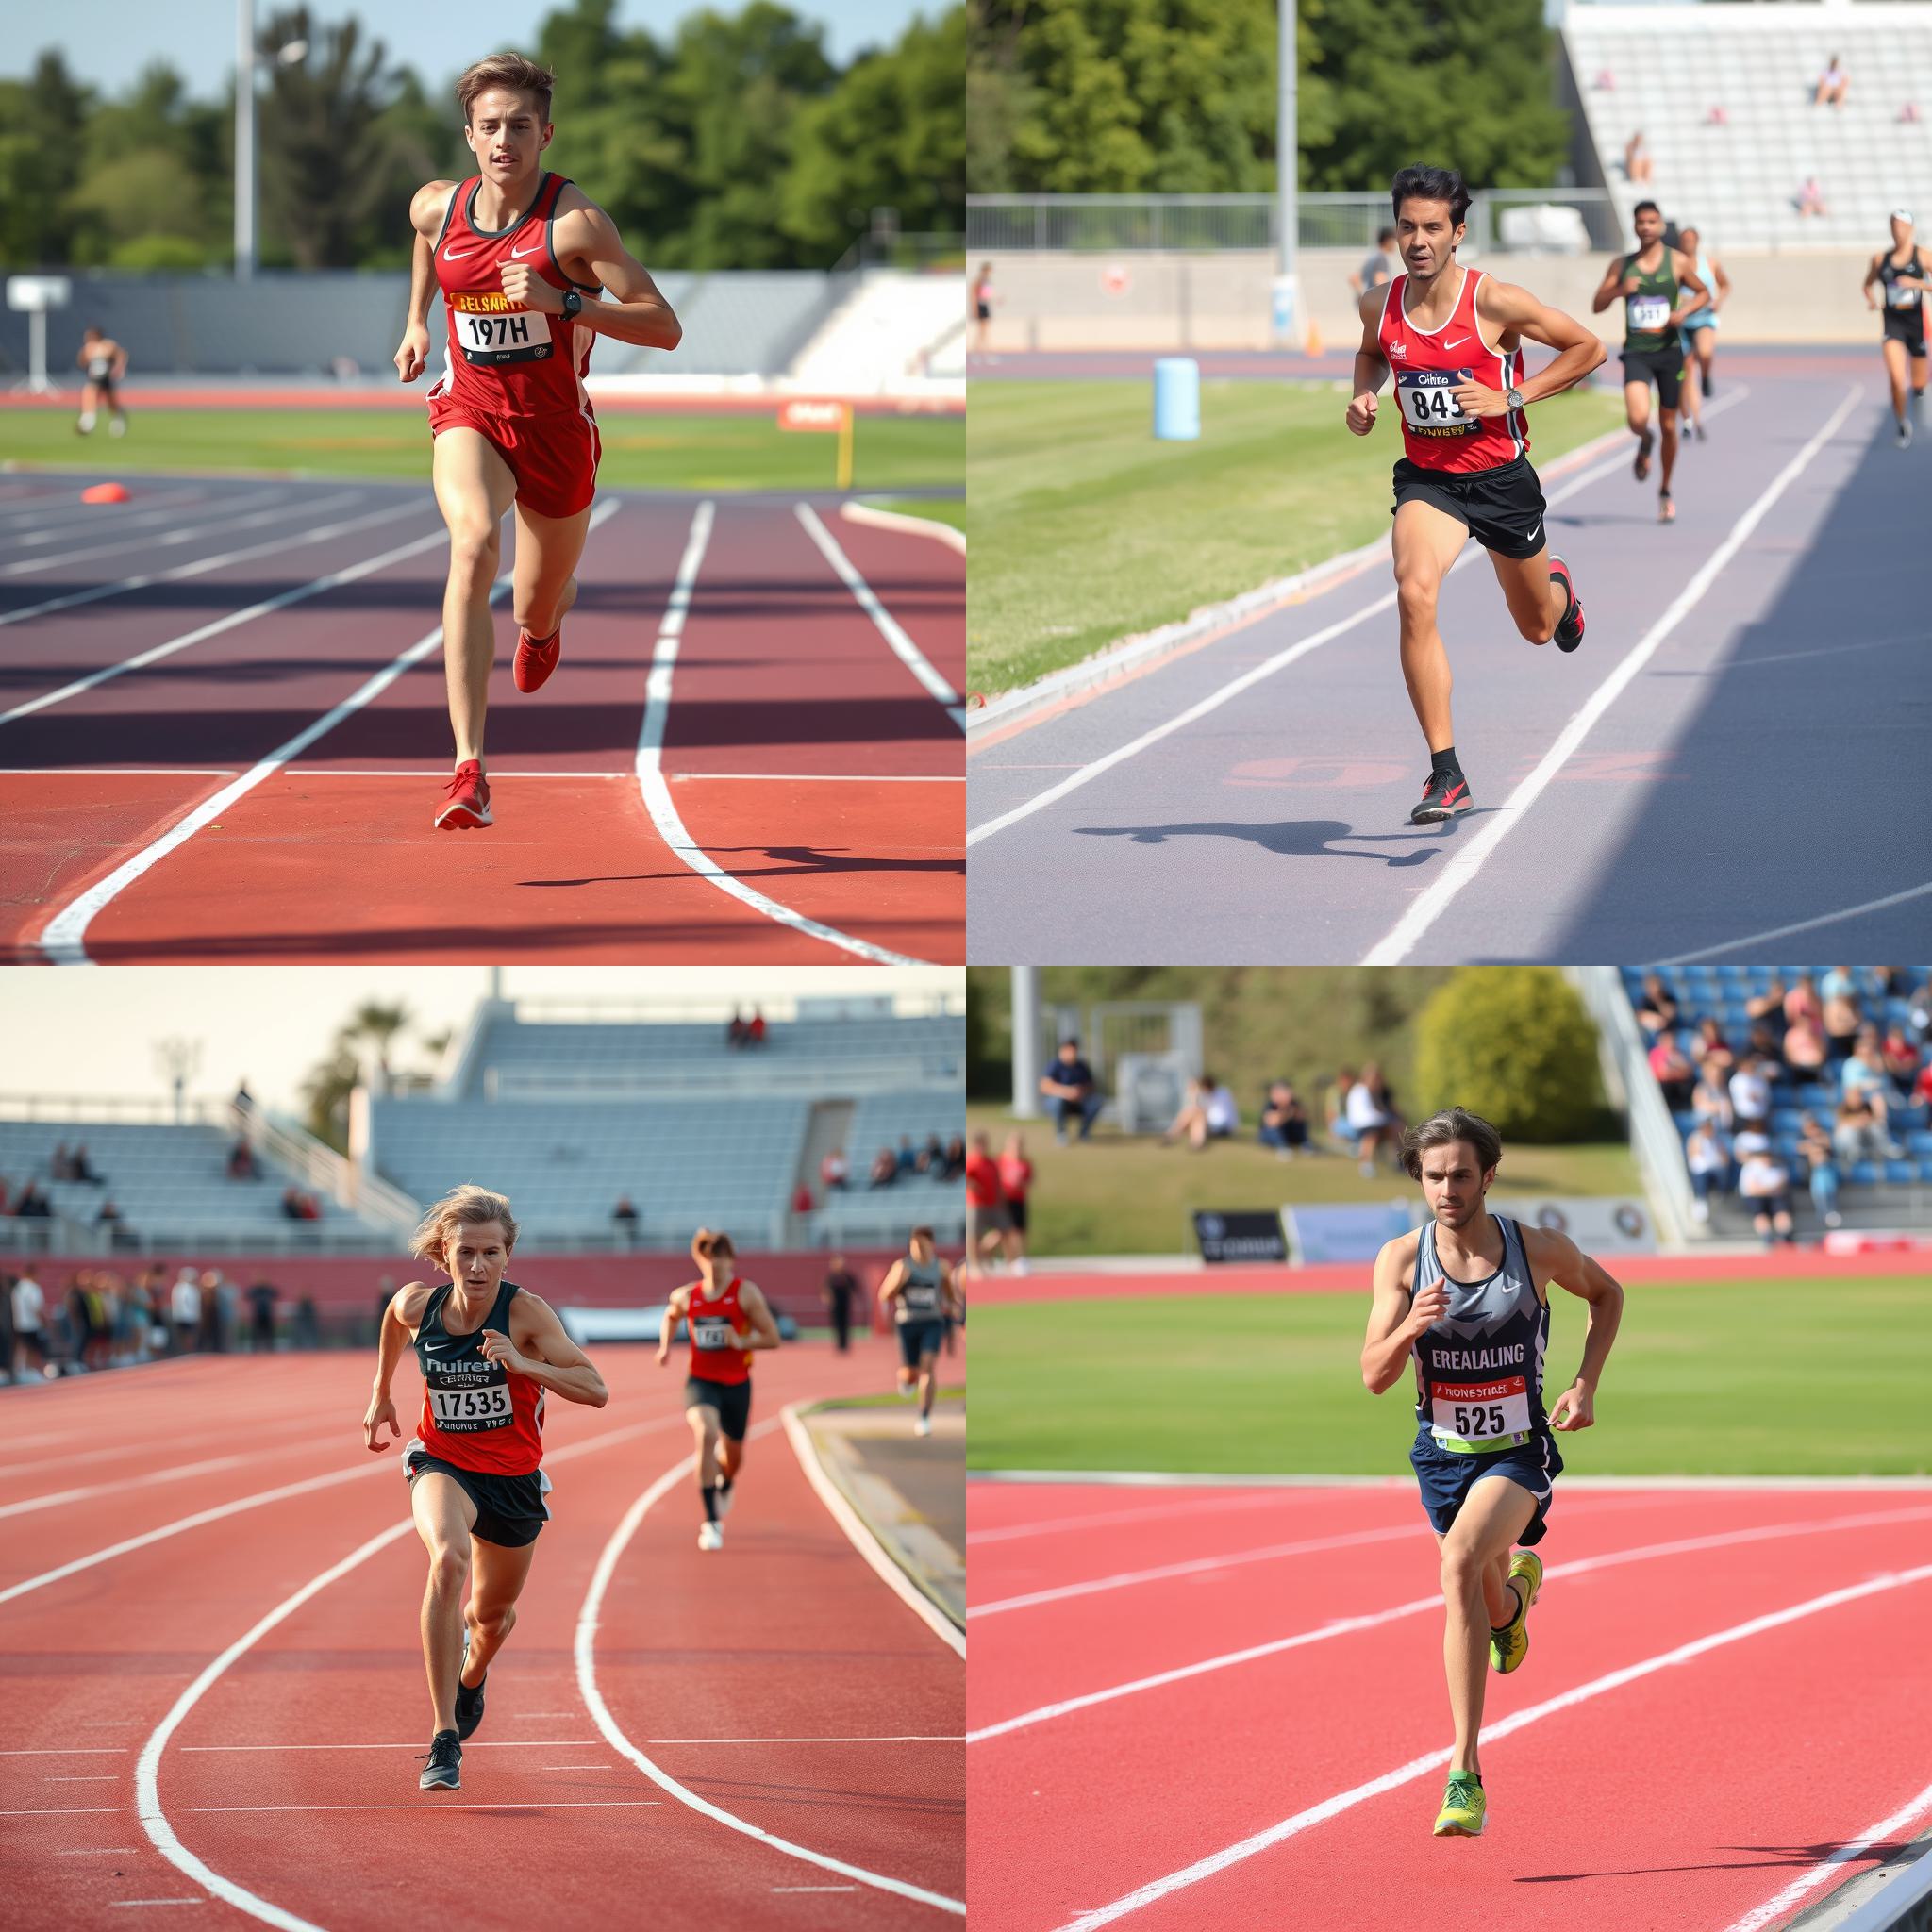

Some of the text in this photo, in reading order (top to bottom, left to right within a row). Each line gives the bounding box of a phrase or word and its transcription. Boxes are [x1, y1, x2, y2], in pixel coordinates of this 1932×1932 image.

[468, 316, 529, 345] 197H
[1431, 1343, 1525, 1370] EREALALING
[437, 1390, 507, 1417] 17535
[1454, 1405, 1506, 1436] 525
